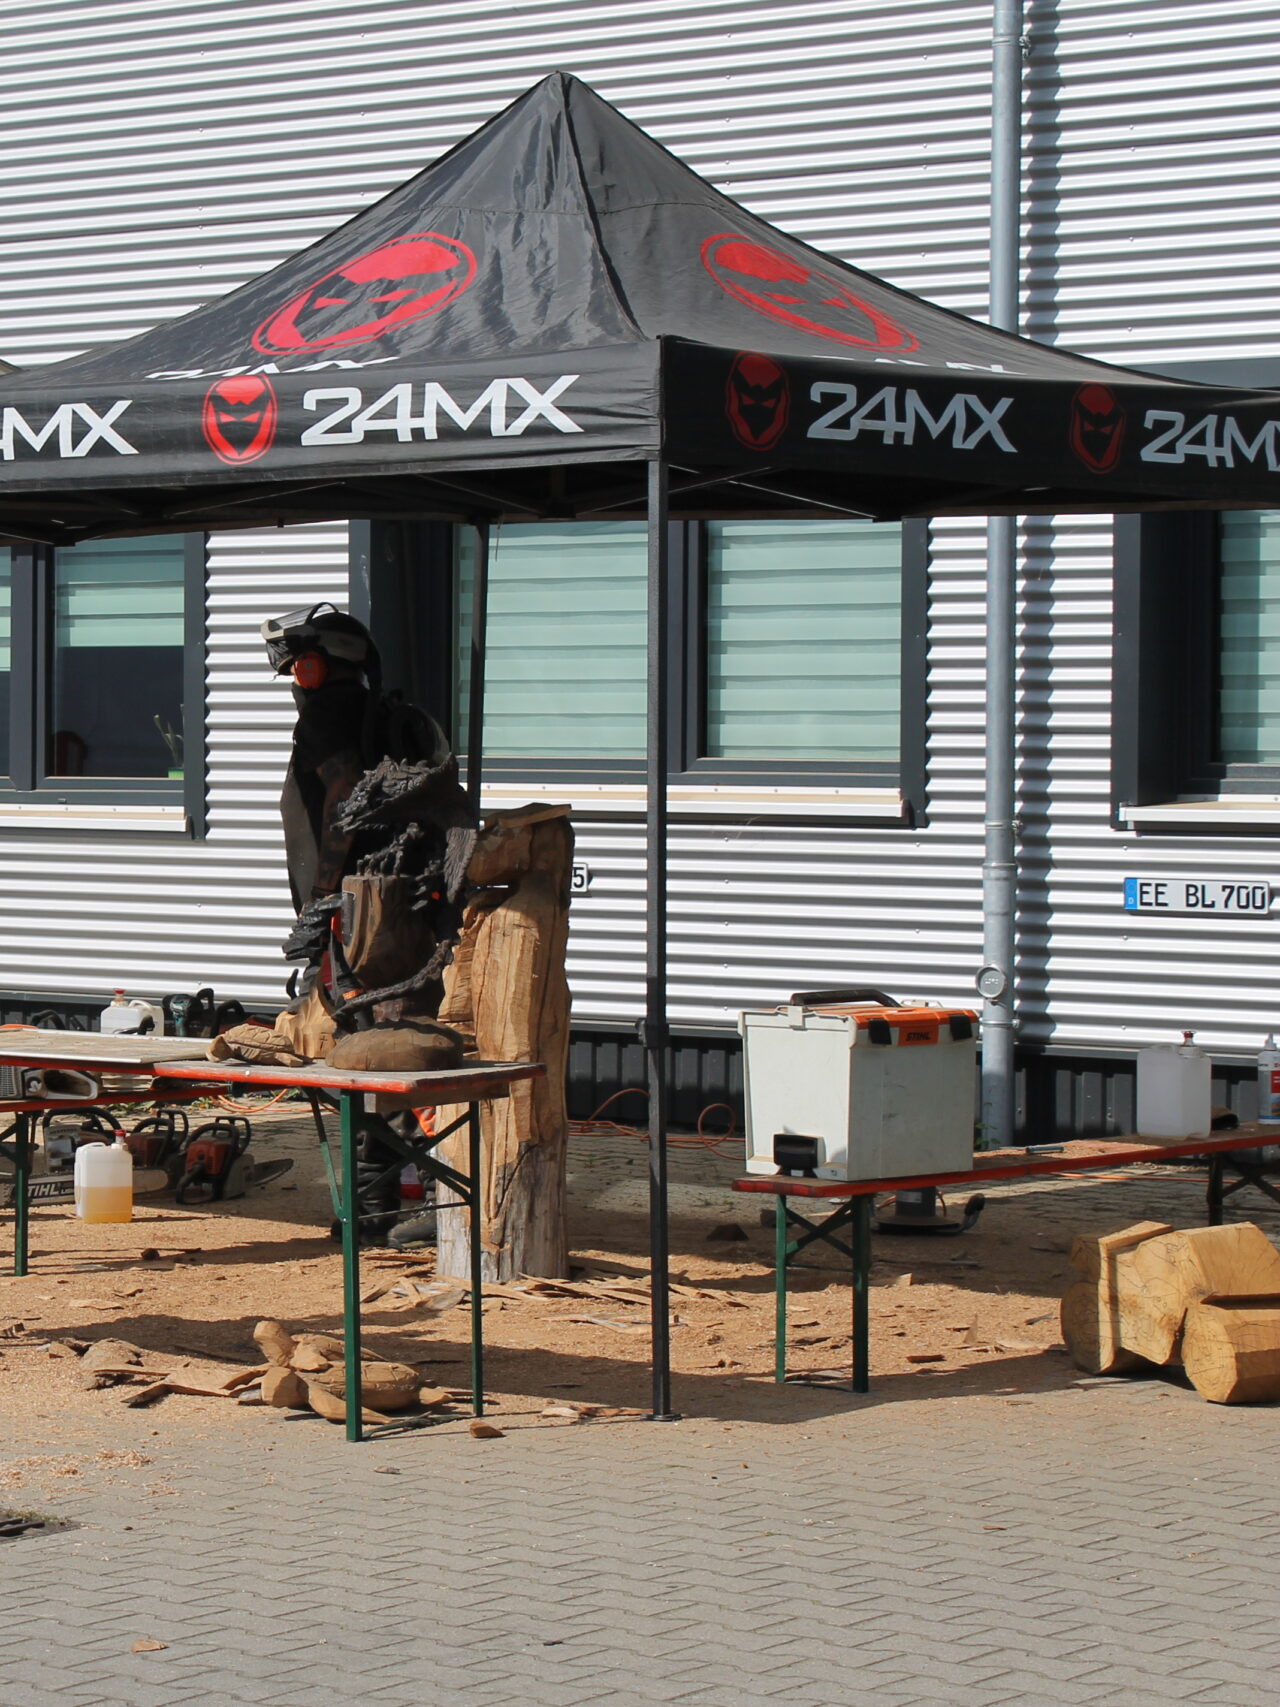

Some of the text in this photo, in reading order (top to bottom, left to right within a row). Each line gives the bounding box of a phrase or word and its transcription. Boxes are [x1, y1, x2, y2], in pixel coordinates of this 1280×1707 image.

[300, 374, 584, 446] 24MX
[807, 381, 1018, 453] 24MX
[1140, 409, 1280, 472] 24M
[1139, 883, 1168, 907] EE
[27, 1184, 60, 1198] TIHL
